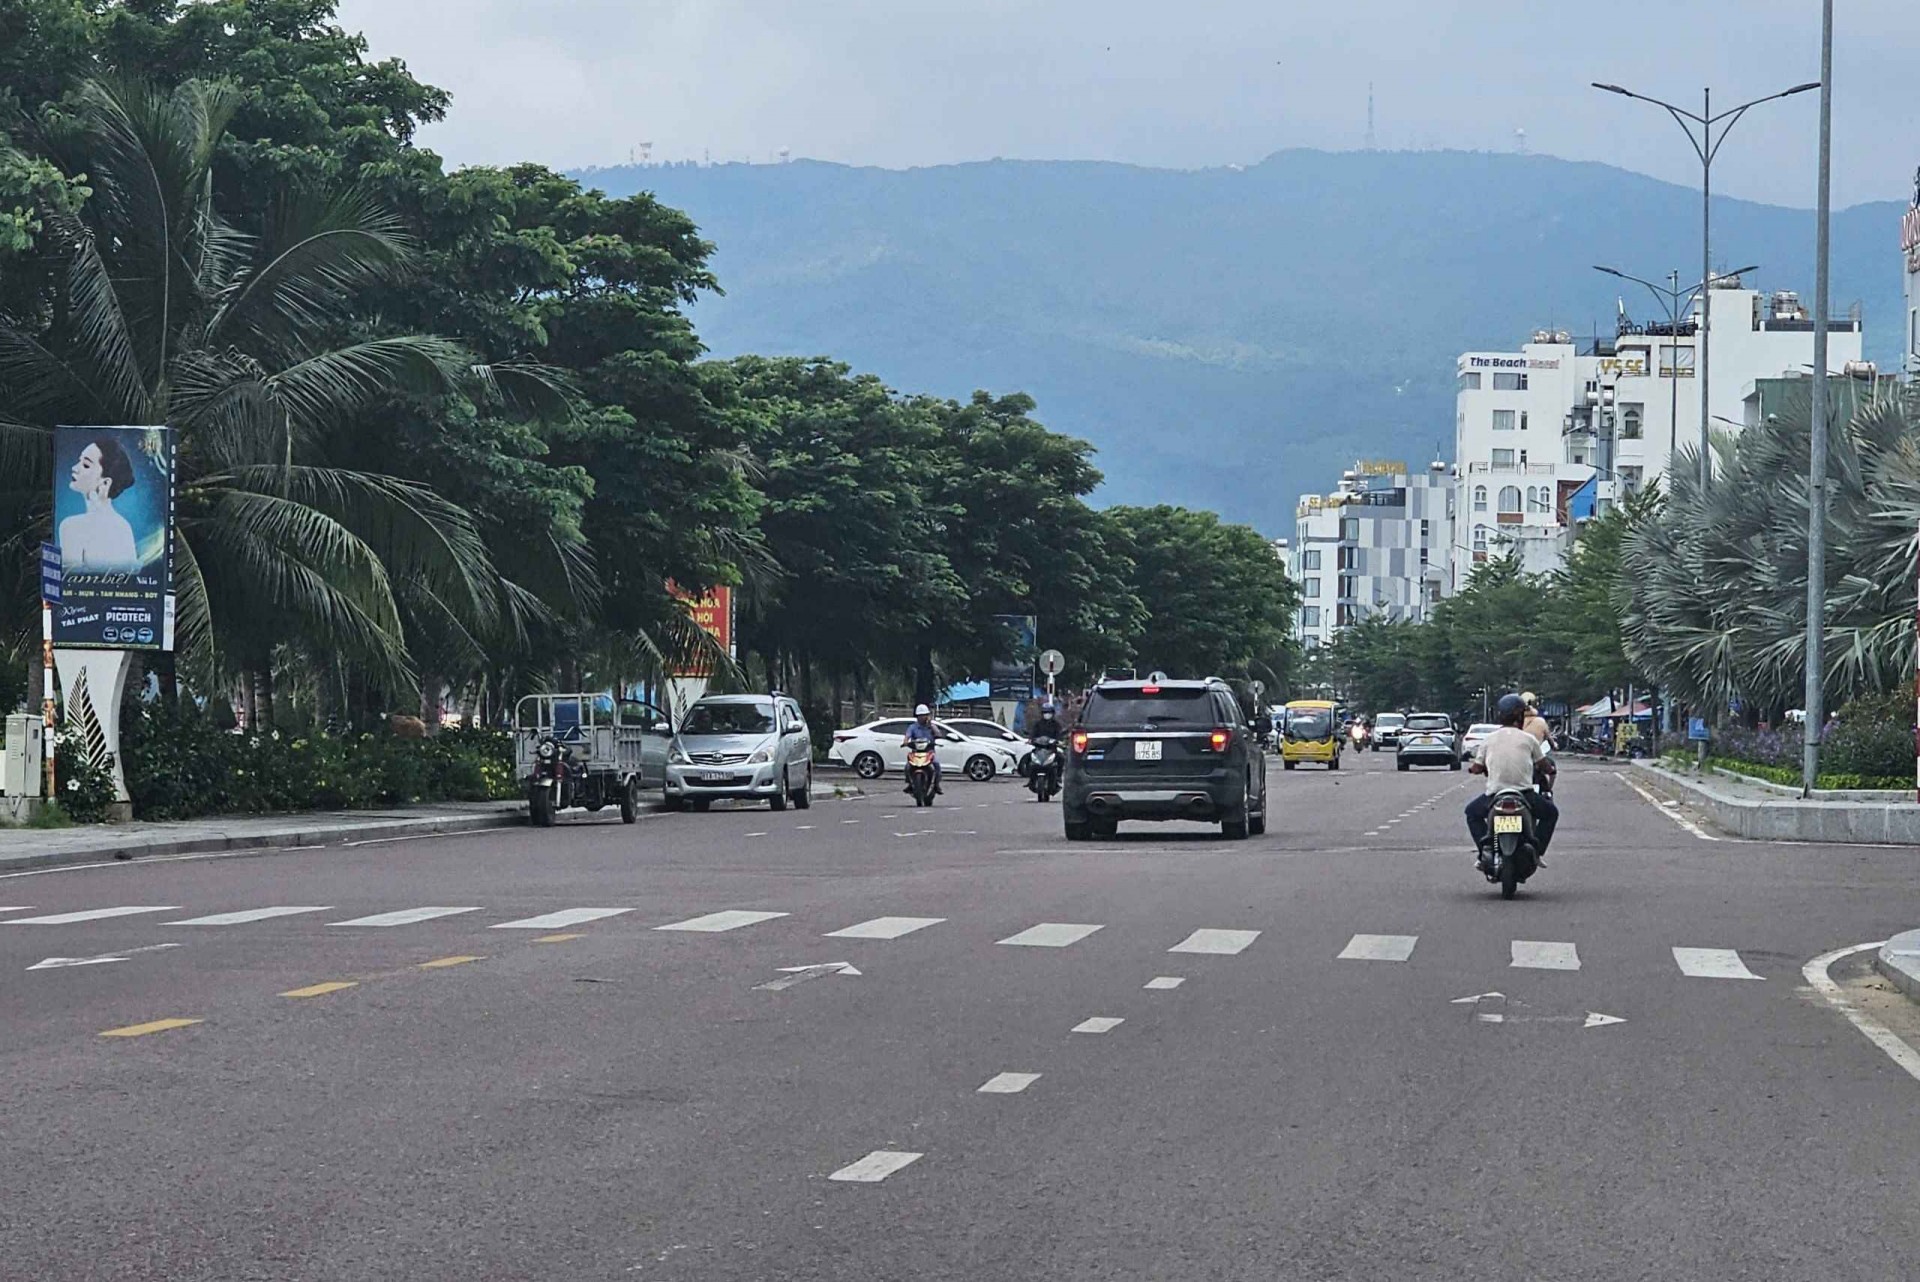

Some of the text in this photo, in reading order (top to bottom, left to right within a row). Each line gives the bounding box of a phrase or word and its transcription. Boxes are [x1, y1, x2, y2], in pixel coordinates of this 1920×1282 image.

[1470, 357, 1489, 366] The
[1492, 357, 1526, 368] Beach
[106, 612, 151, 622] PICOTECH
